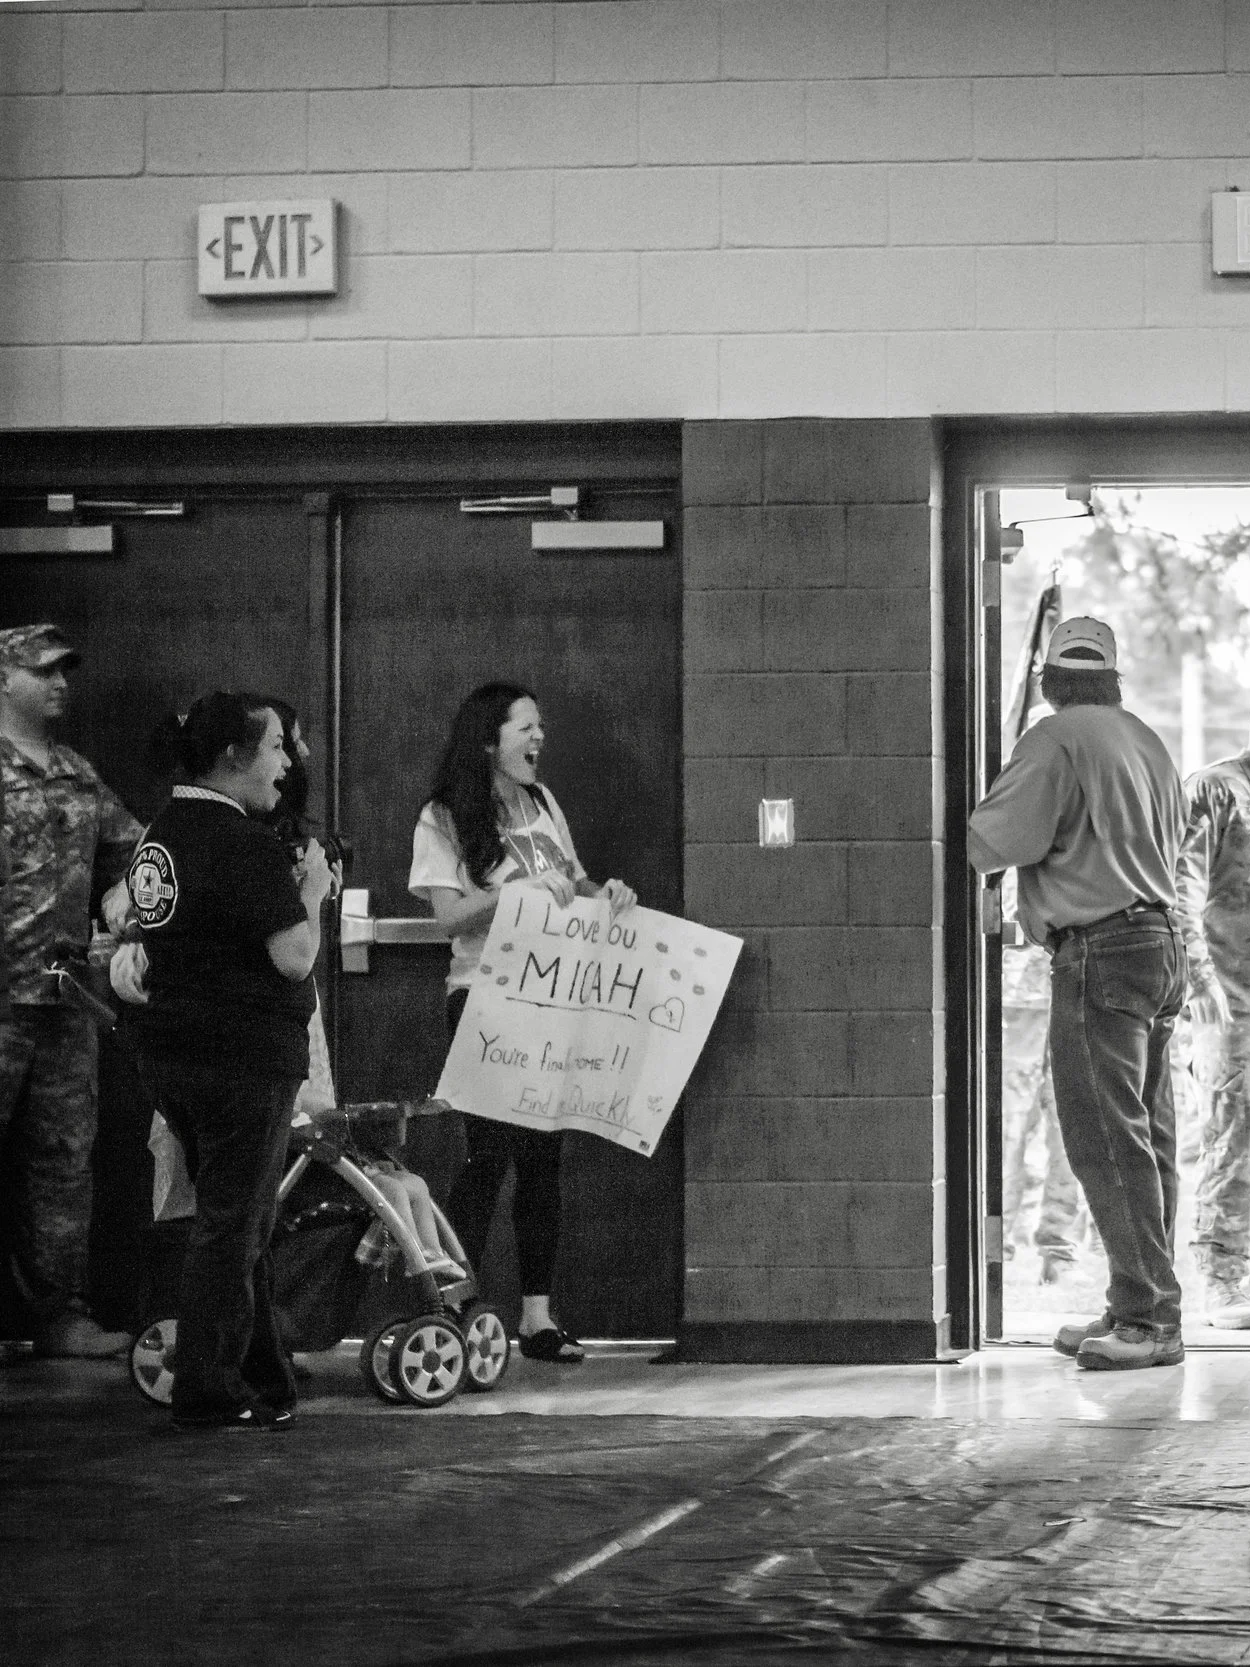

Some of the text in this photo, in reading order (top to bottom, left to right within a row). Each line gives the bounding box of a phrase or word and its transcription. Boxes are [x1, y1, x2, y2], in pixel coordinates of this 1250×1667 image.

[224, 214, 312, 281] EXIT
[148, 849, 168, 878] PROUD
[513, 897, 523, 929] I
[519, 951, 643, 1009] MICAH
[518, 1087, 553, 1115] Find
